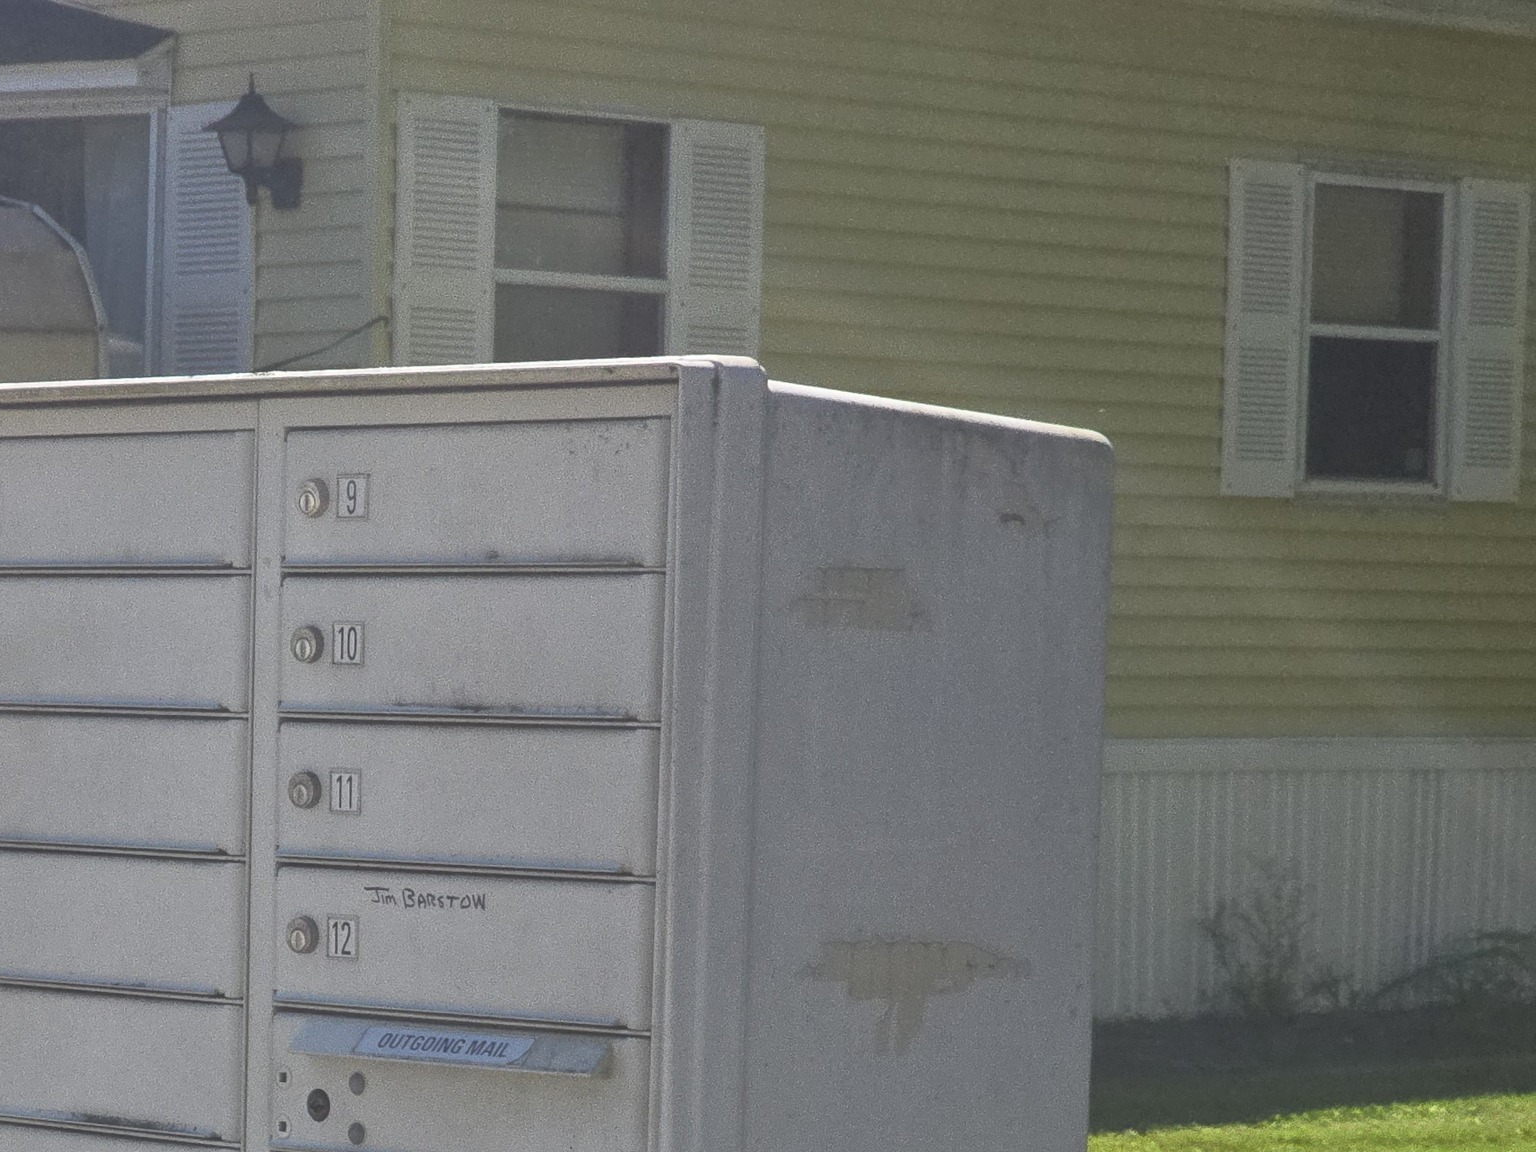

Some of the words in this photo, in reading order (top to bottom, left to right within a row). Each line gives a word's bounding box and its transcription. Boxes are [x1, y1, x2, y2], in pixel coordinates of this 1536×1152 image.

[347, 480, 357, 515] 9
[338, 626, 357, 661] 10
[336, 775, 353, 809] 11
[332, 920, 351, 955] 12
[378, 1032, 466, 1055] OUTGOING
[464, 1039, 511, 1058] MAIL
